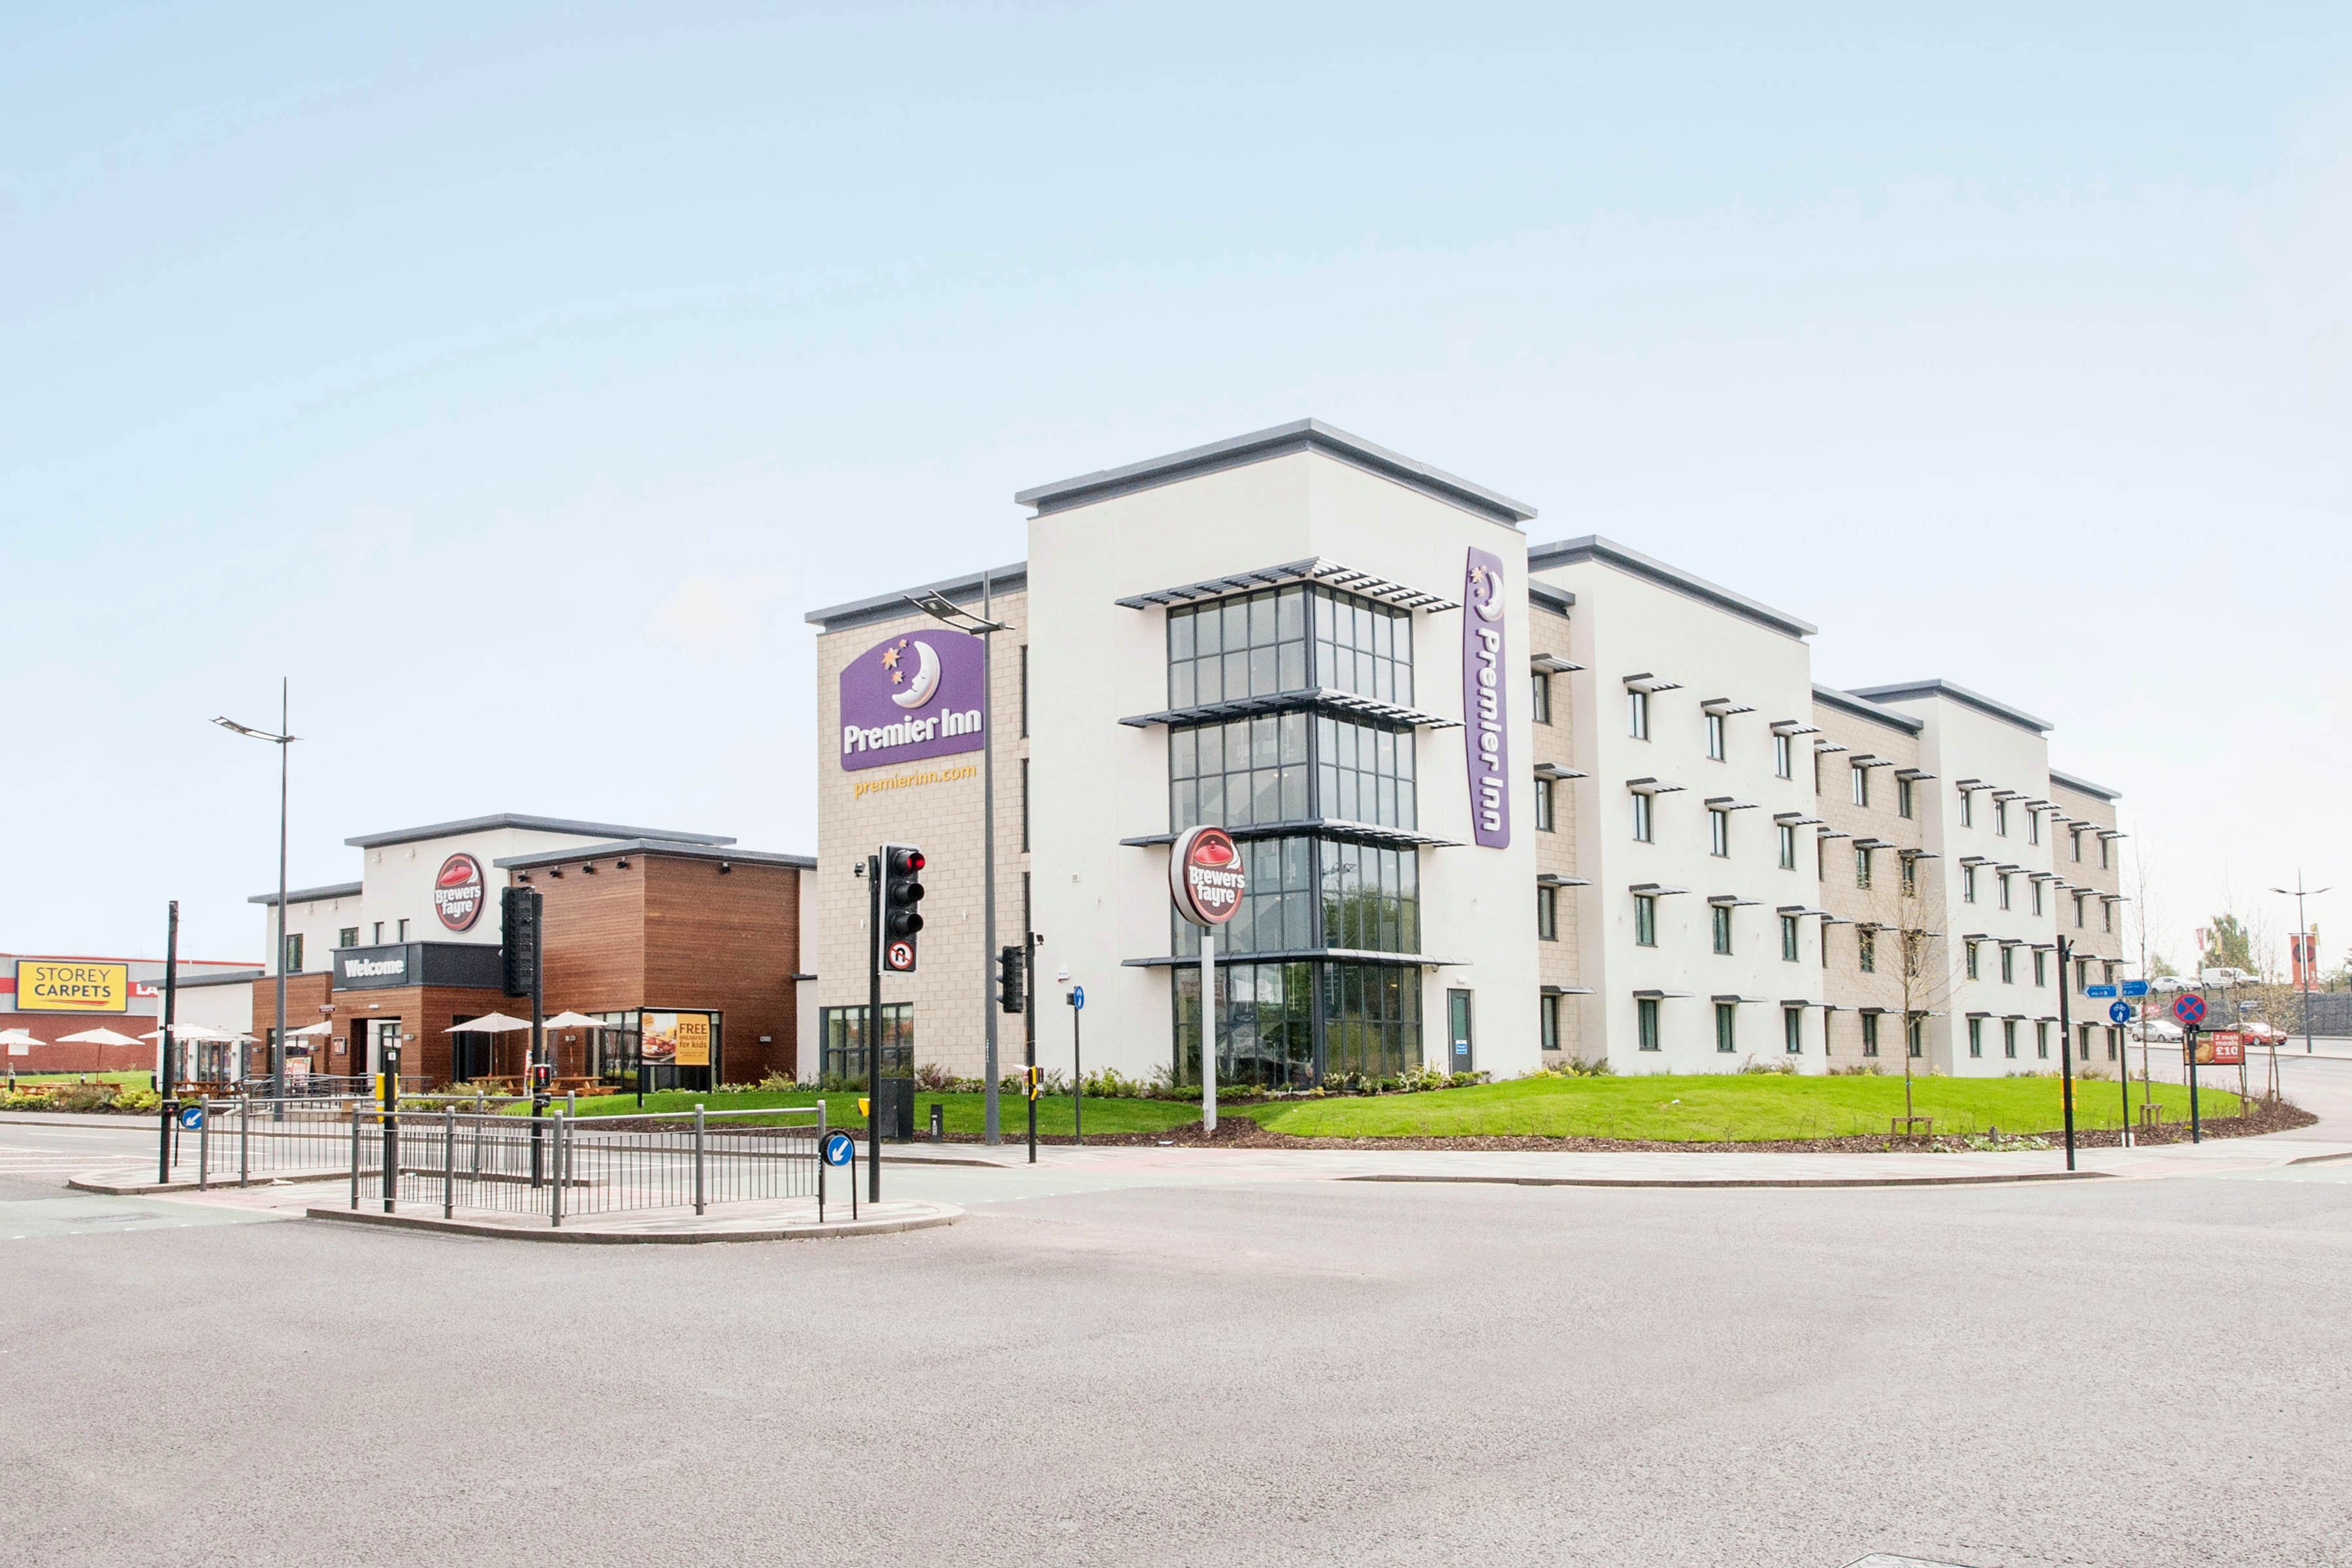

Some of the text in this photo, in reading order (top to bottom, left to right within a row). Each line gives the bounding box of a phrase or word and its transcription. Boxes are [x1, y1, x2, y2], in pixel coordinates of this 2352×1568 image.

[844, 708, 982, 754] Premier Inn
[1478, 627, 1503, 832] Premier Inn
[854, 766, 976, 799] premierinn.com
[1188, 866, 1245, 889] Brewers
[434, 885, 481, 904] Brewers
[1197, 881, 1235, 907] fayre
[442, 899, 473, 917] fayre
[36, 967, 110, 983] STOREY
[344, 958, 404, 977] Welcome
[34, 984, 110, 998] CARPETS
[679, 1023, 708, 1034] FREE
[2215, 1046, 2238, 1055] £10
